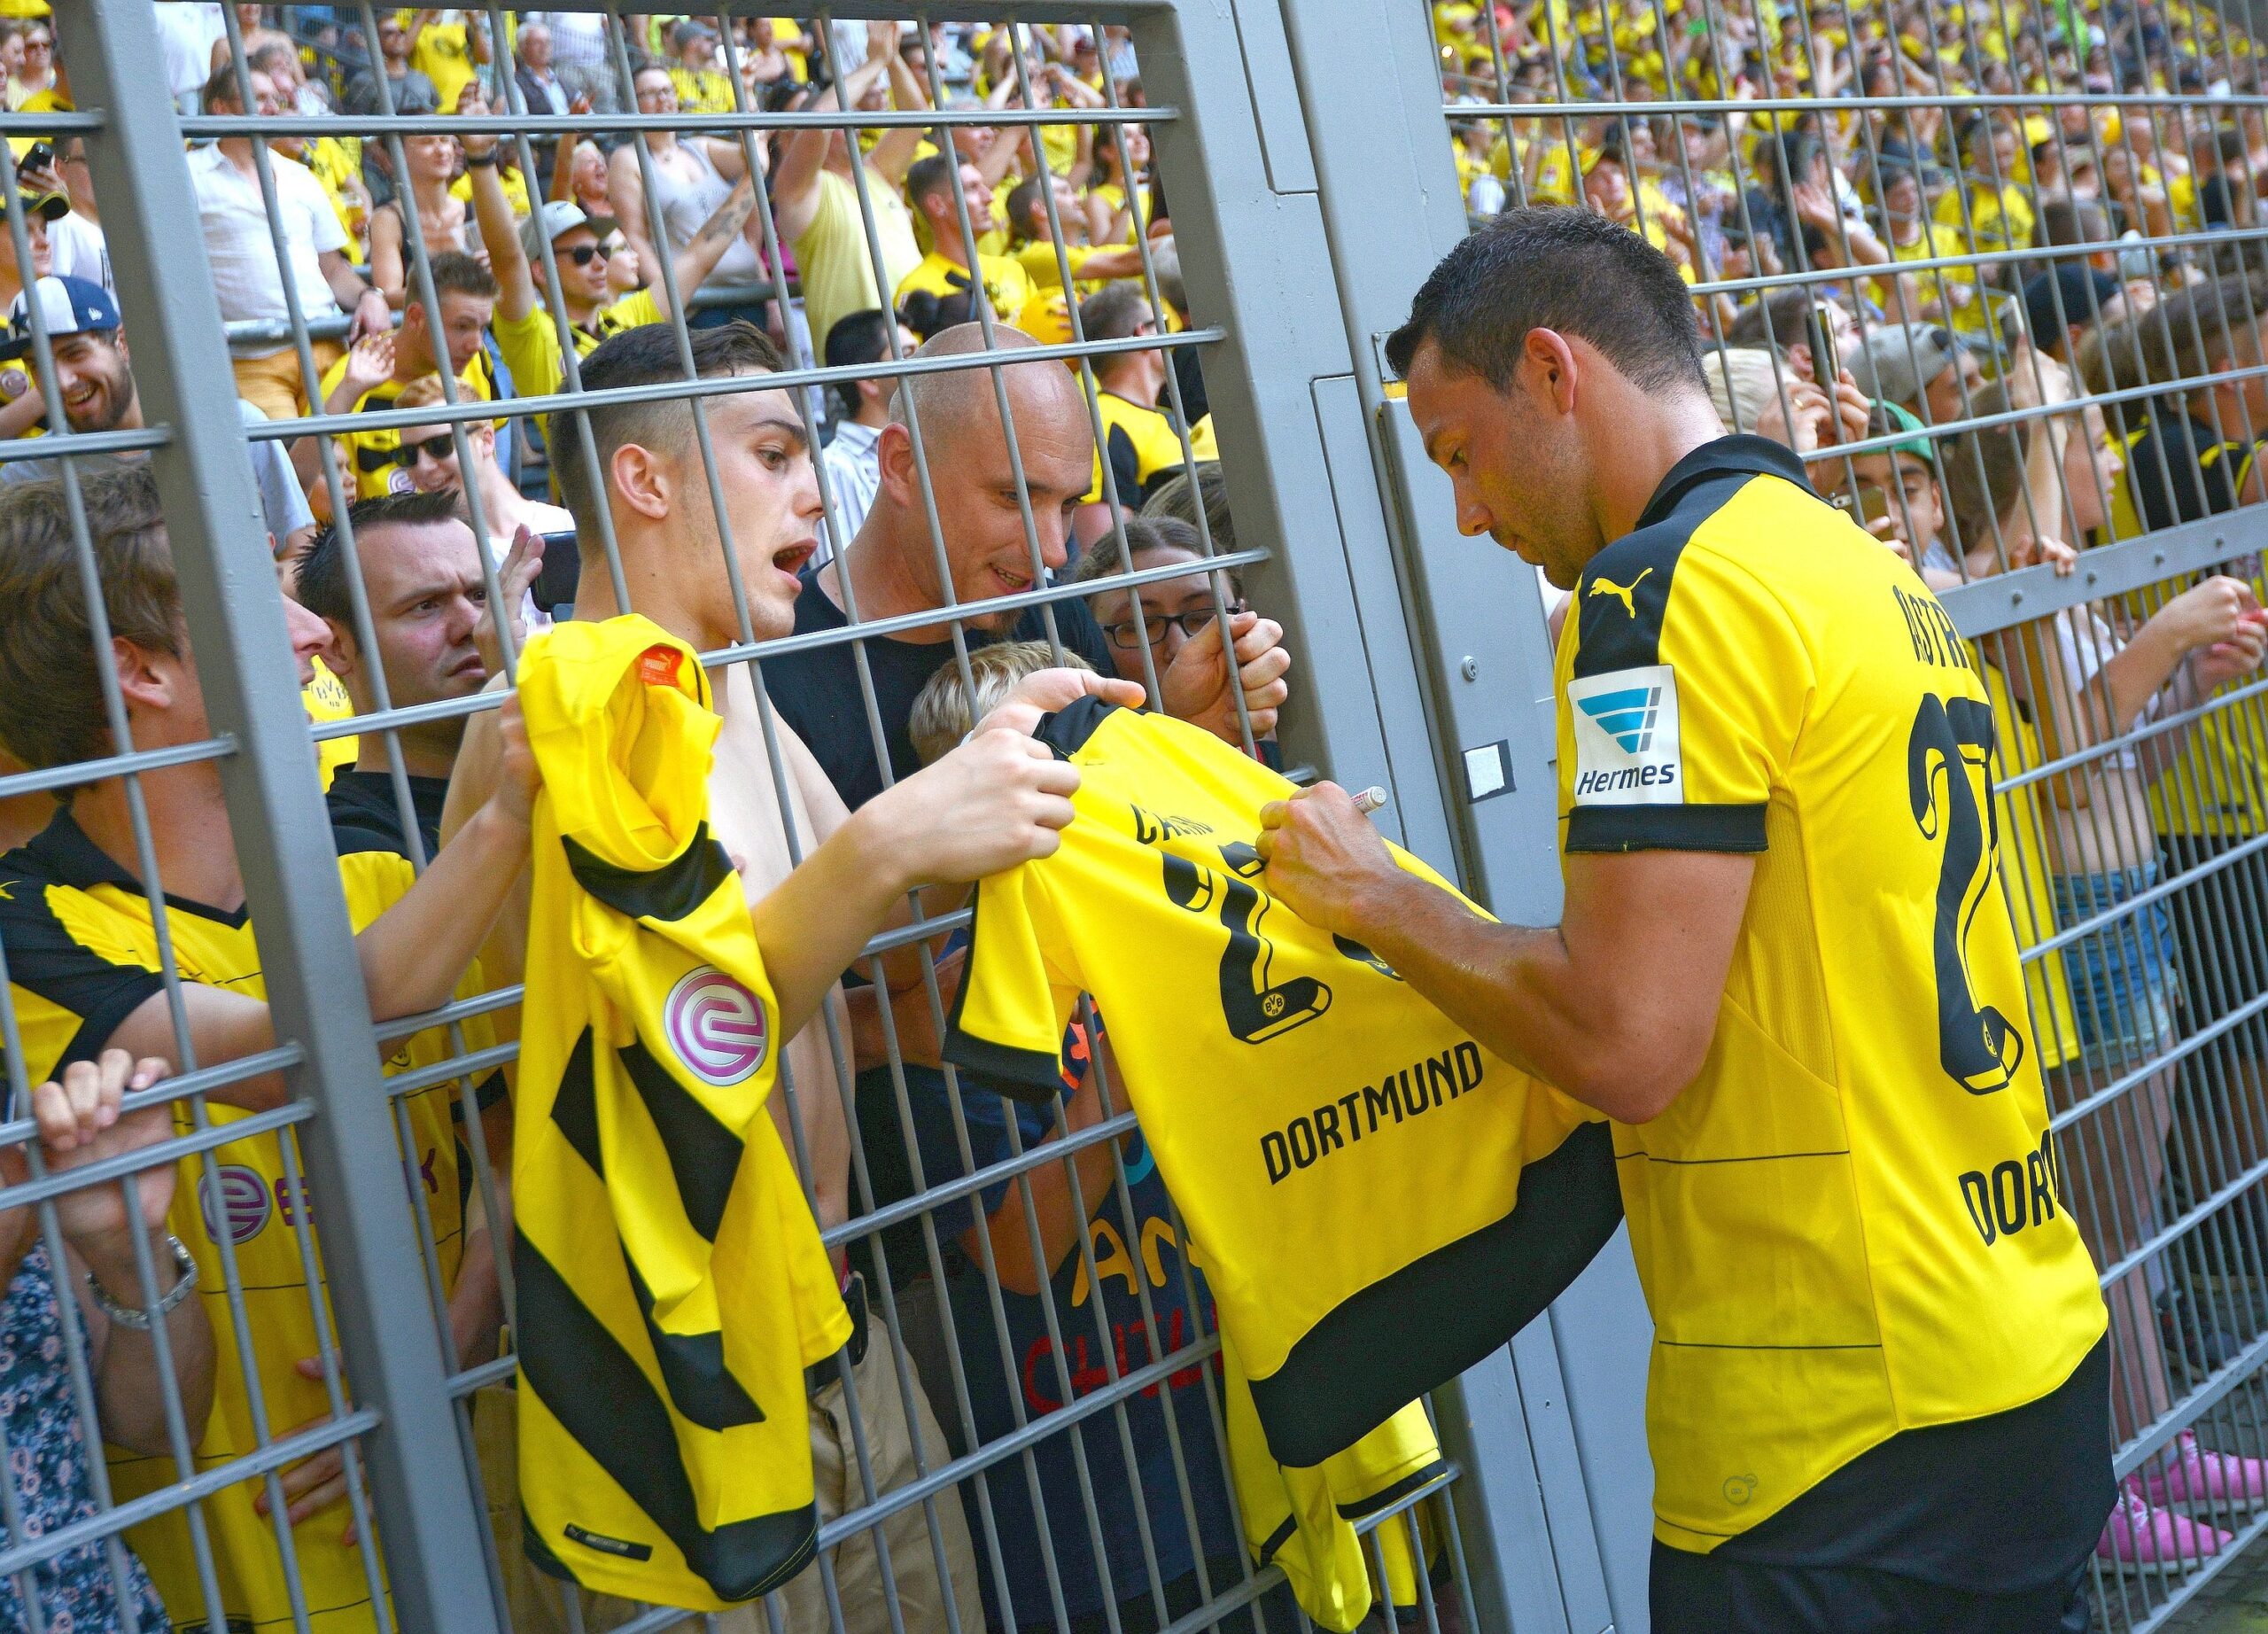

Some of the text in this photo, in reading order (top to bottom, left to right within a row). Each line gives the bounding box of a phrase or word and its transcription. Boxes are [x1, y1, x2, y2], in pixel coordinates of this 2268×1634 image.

[1577, 764, 1675, 796] Hermes
[1265, 994, 1283, 1013] BVB
[1260, 1040, 1484, 1186] DORTMUND
[1025, 1300, 1224, 1414] CHIL
